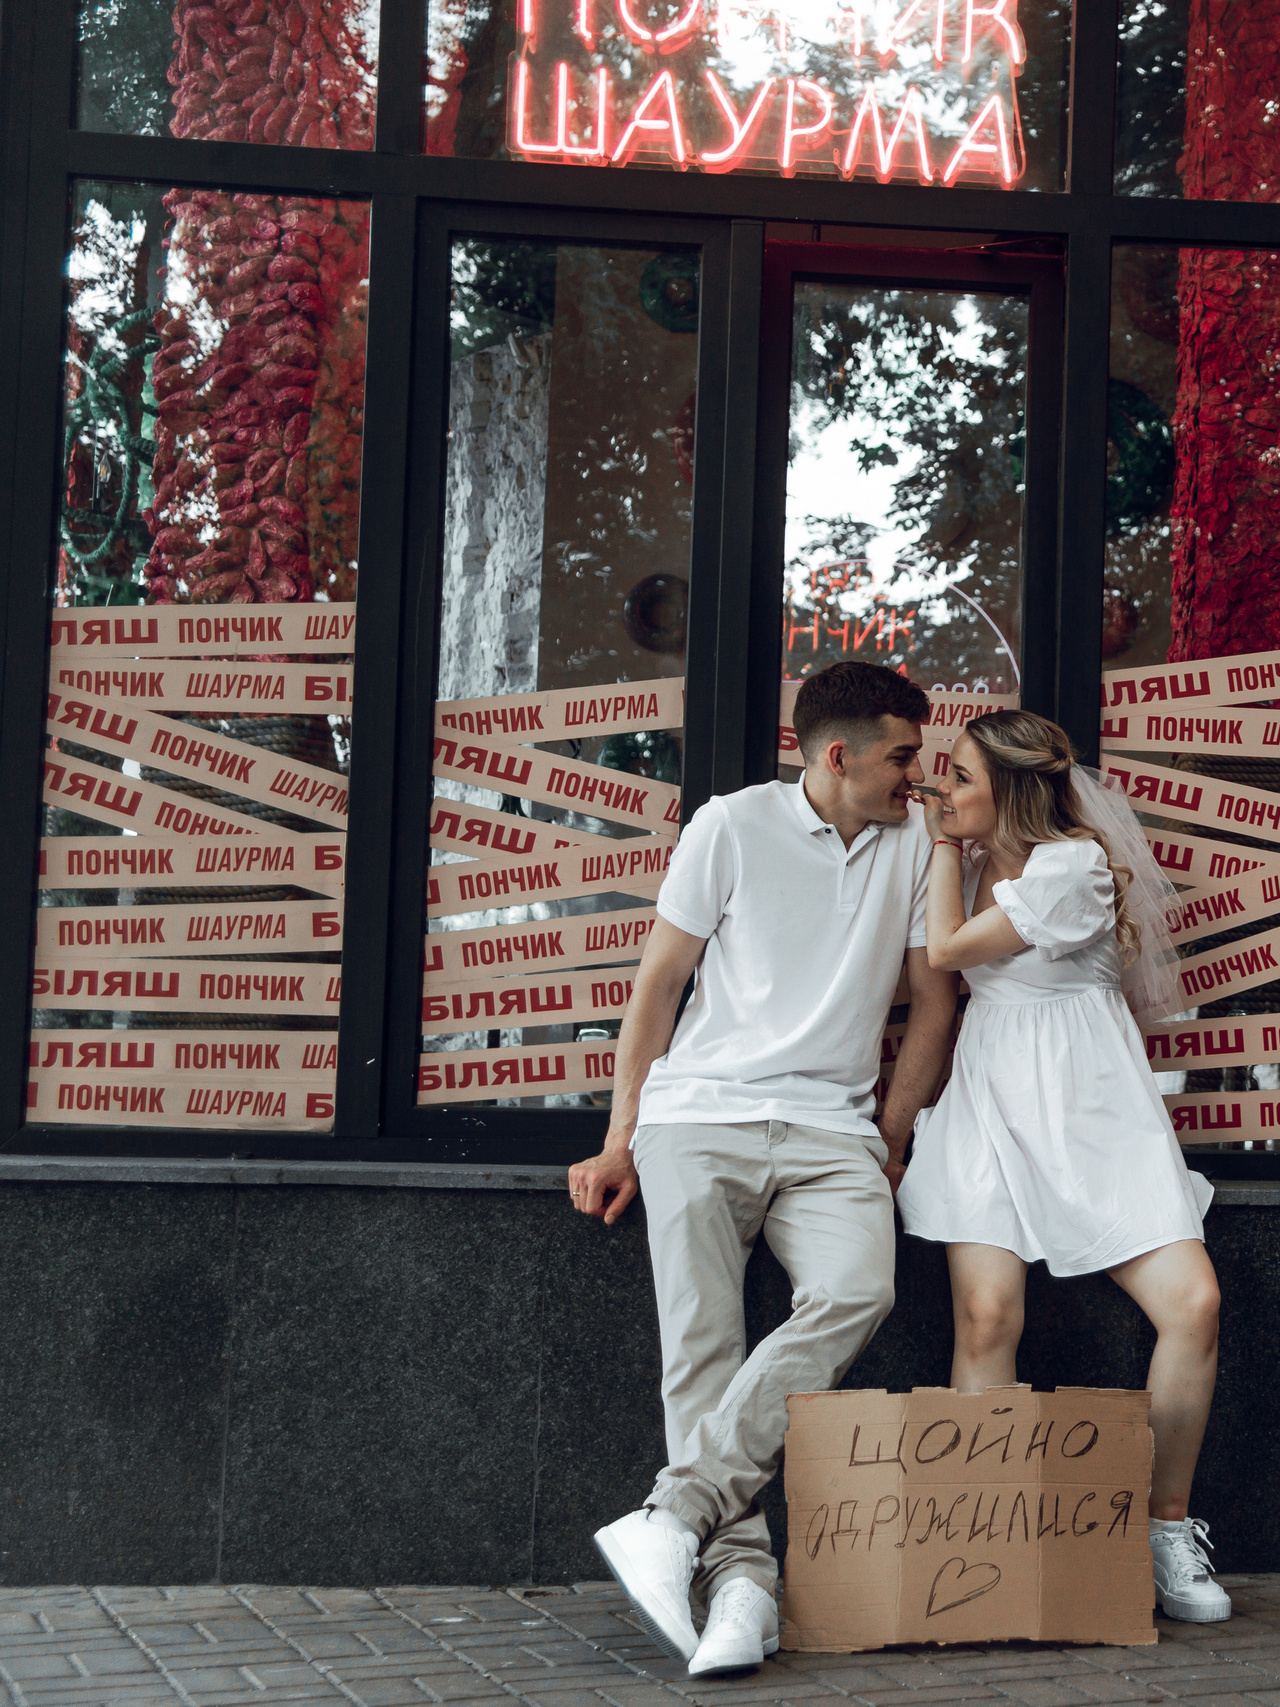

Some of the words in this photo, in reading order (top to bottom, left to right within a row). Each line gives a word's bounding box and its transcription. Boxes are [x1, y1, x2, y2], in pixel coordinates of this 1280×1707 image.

[516, 61, 1014, 182] ШАУРМА
[50, 618, 158, 645] ЛЯШ
[178, 616, 284, 643] ПОНЧИК
[304, 615, 355, 640] ШАУ
[186, 673, 285, 700] ШАУРМА
[1101, 671, 1211, 708] ІЛЯШ
[564, 693, 659, 727] ШАУРМА
[1146, 715, 1243, 745] ПОНЧИК
[47, 692, 139, 744] ЛЯШ
[150, 728, 256, 784] ПОНЧИК
[269, 769, 348, 816] ШАУРМ
[44, 761, 143, 817] ЛЯШ
[433, 737, 533, 785] ЛЯШ
[546, 767, 649, 815] ПОНЧИК
[1106, 767, 1203, 812] ЛЯШ
[430, 810, 537, 854] ЛЯШ
[67, 849, 174, 876] ПОНЧИК
[195, 846, 295, 873] ШАУРМА
[458, 862, 562, 901] ПОНЧИК
[58, 918, 165, 946] ПОНЧИК
[187, 914, 286, 942] ШАУРМА
[461, 930, 565, 968] ПОНЧИК
[585, 918, 655, 952] ШАУР
[199, 974, 305, 1002] ПОНЧИК
[1181, 943, 1278, 996] ПОНЧИК
[422, 984, 573, 1022] БІЛЯШ
[28, 1042, 155, 1069] ІЛЯШ
[174, 1043, 281, 1070] ПОНЧИК
[1146, 1028, 1245, 1060] ЛЯШ
[418, 1055, 566, 1092] БІЛЯШ
[58, 1083, 165, 1113] ПОНЧИК
[186, 1089, 287, 1117] ШАУРМА
[848, 1407, 1099, 1475] ЩОЙНО
